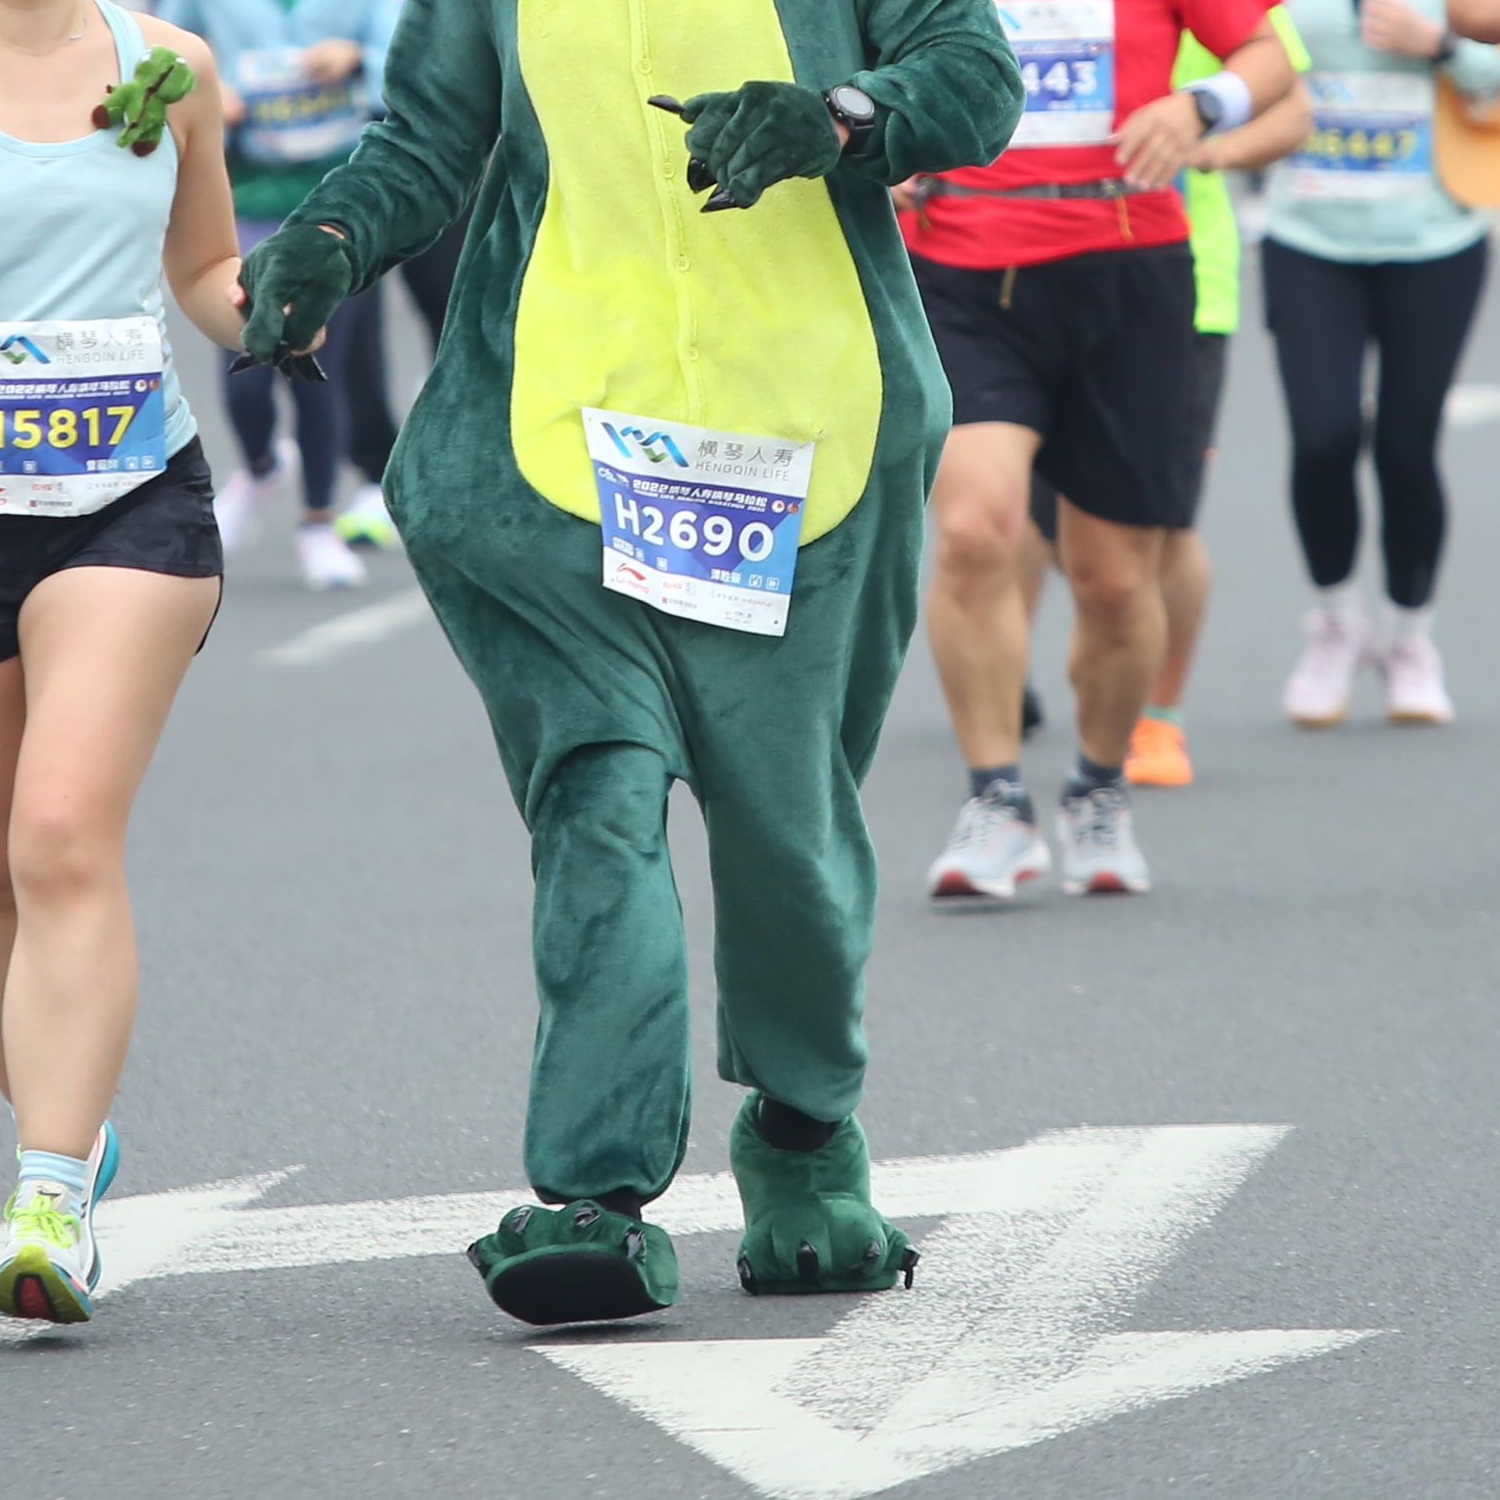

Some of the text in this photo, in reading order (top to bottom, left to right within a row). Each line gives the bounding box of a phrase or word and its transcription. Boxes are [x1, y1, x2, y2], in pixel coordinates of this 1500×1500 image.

[56, 329, 143, 350] 横琴人寿
[56, 350, 144, 365] HENGQIN LIFE
[697, 439, 794, 468] 横琴人寿
[695, 461, 790, 482] HENGQIN LIFE
[614, 493, 773, 562] H2690
